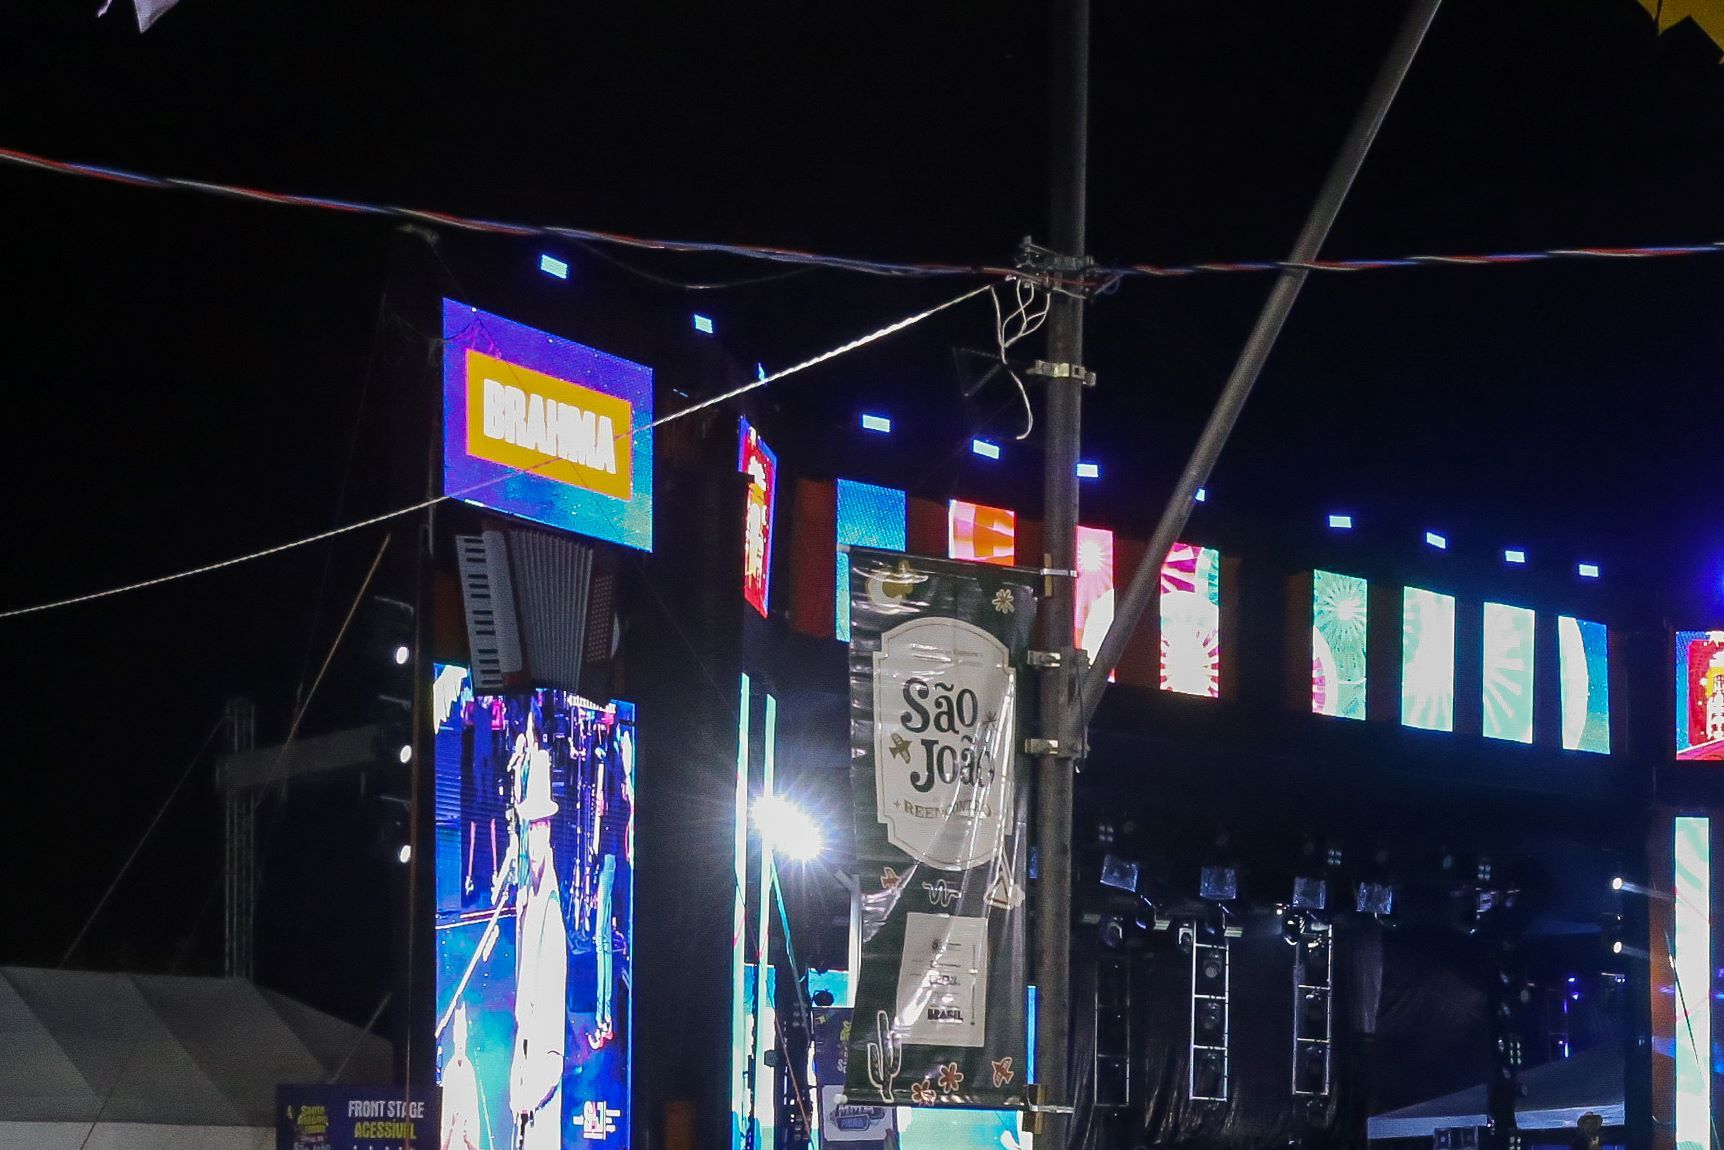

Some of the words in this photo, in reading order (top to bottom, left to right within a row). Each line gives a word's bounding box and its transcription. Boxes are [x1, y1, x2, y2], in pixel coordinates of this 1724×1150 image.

[483, 378, 616, 474] BRAHMA
[900, 677, 978, 735] São
[910, 734, 995, 793] João
[348, 1100, 385, 1118] FRONT
